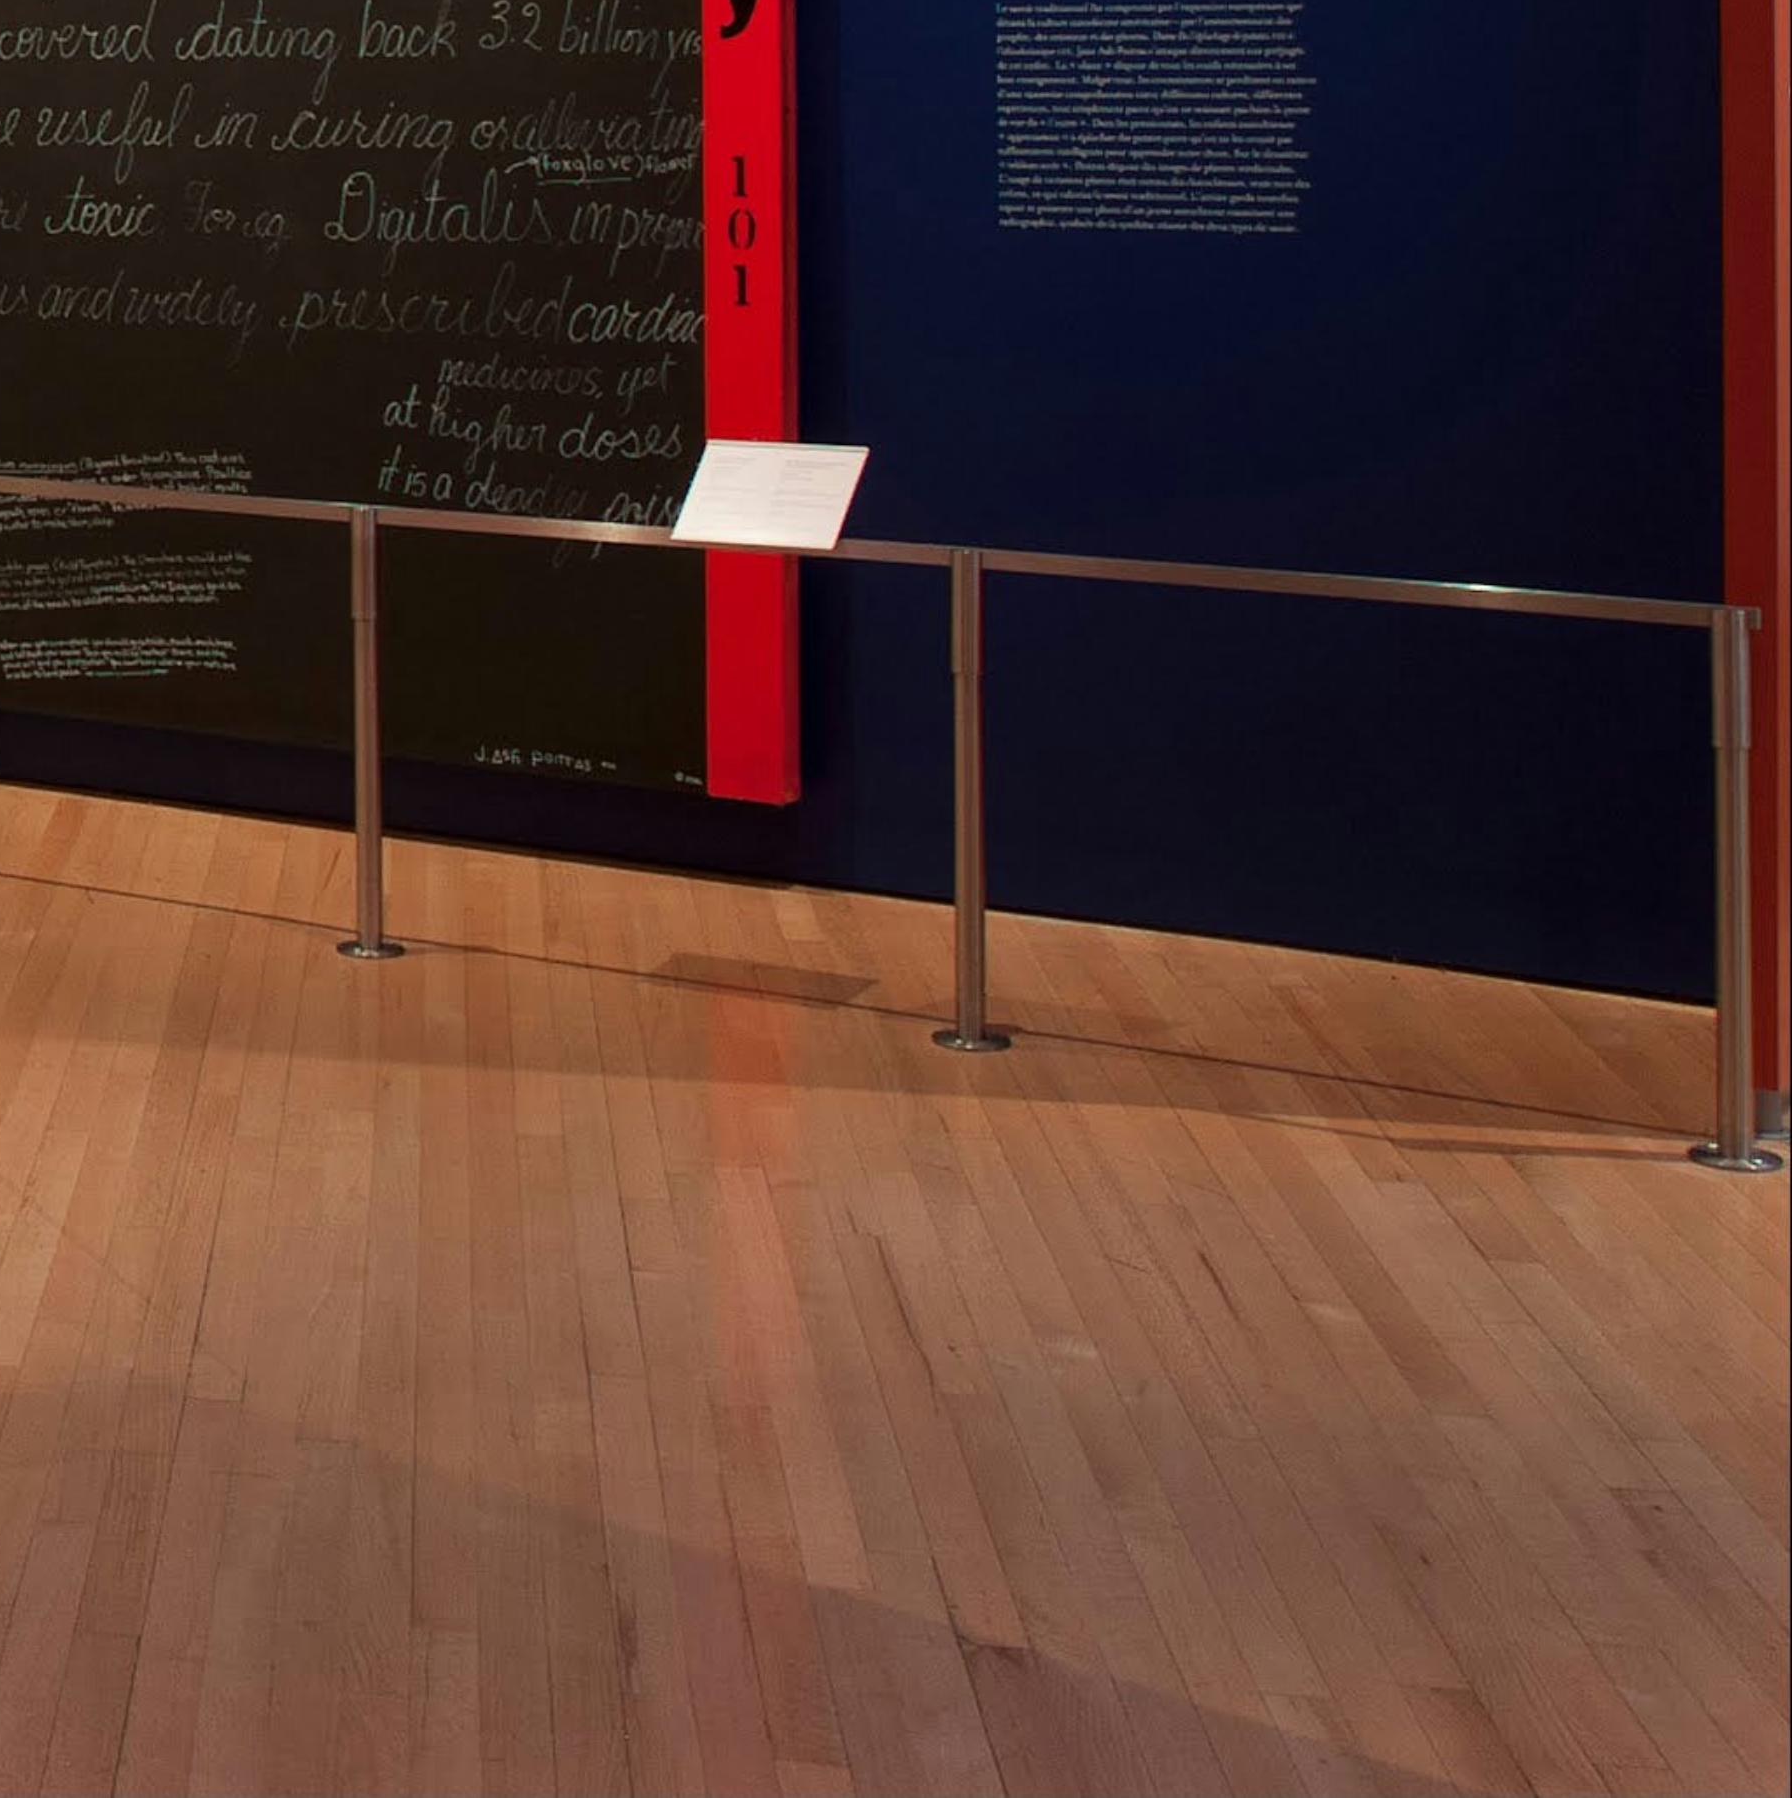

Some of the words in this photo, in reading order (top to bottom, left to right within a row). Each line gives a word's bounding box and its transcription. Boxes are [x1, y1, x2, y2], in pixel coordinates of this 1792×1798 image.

[36, 80, 194, 185] useful
[194, 102, 256, 149] in
[270, 101, 455, 196] curing
[727, 155, 756, 307] 101
[383, 385, 420, 429] at
[558, 412, 683, 461] doses
